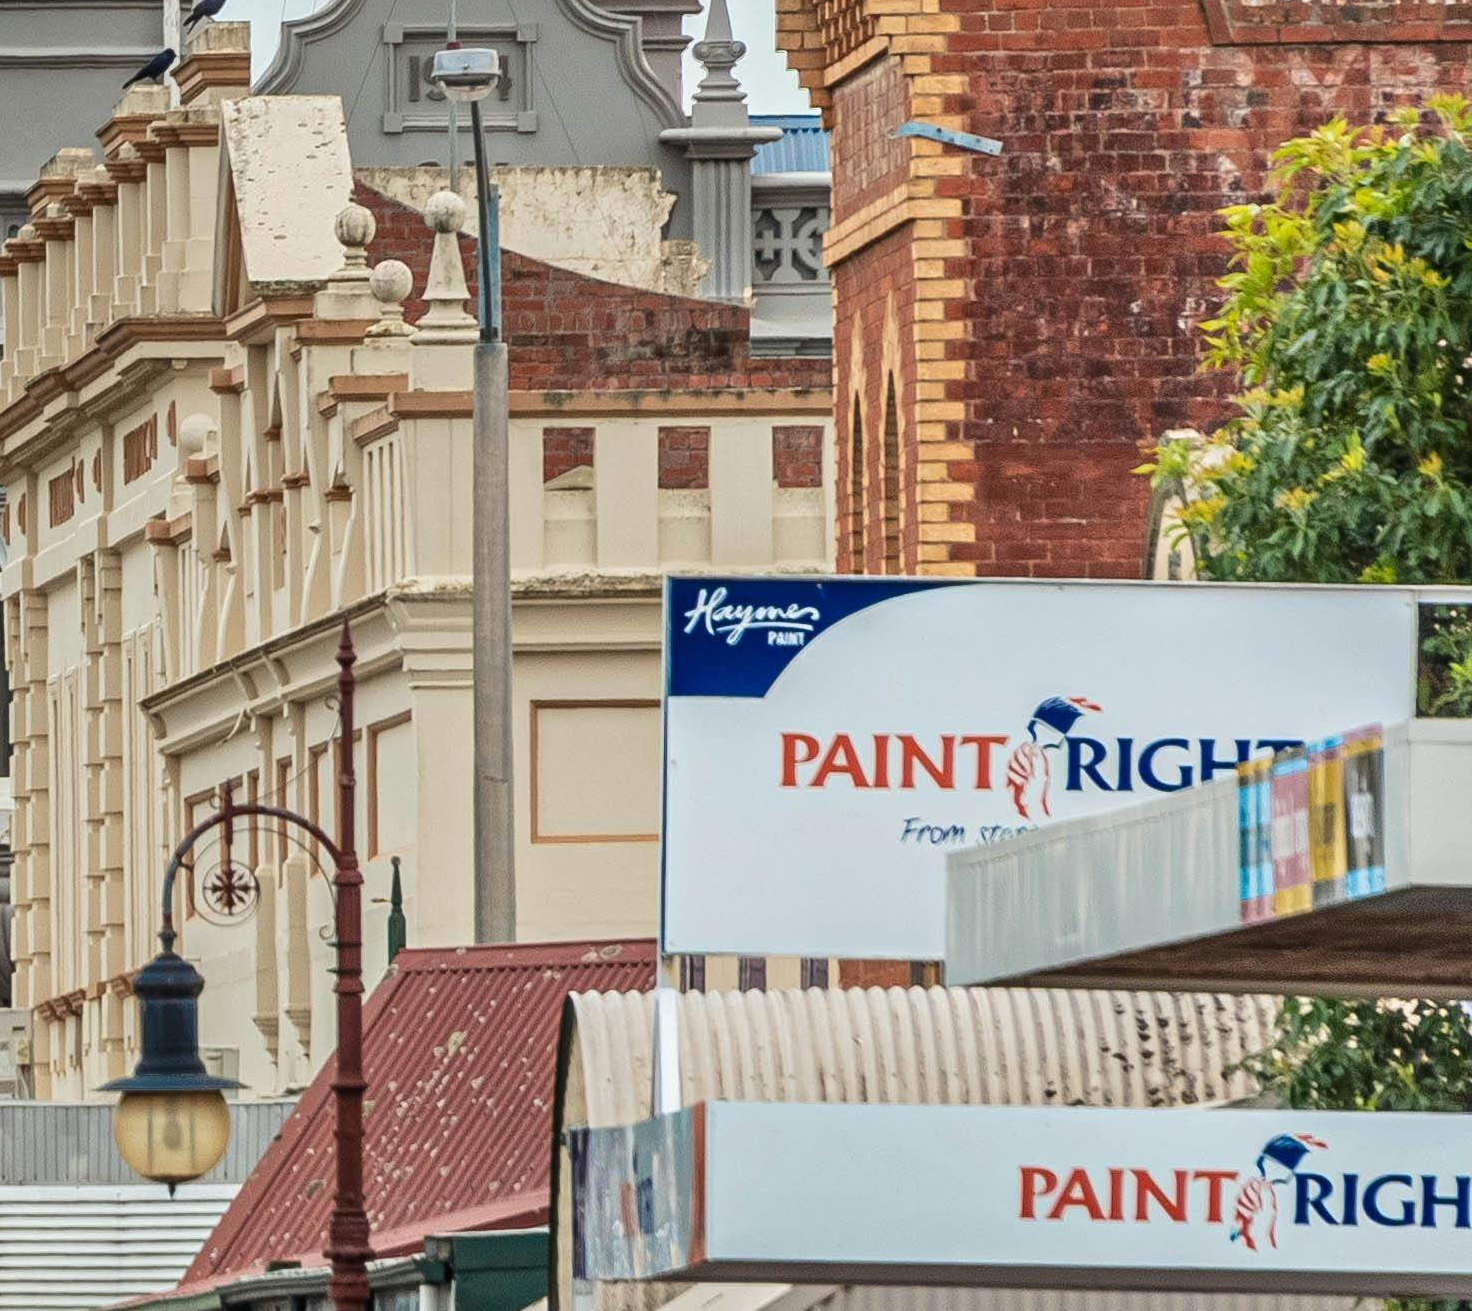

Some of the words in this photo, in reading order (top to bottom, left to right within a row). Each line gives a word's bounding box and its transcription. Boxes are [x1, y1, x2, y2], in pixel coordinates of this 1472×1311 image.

[684, 587, 821, 646] Haymes
[768, 631, 805, 646] PAINT
[779, 732, 1008, 790] PAINT
[901, 817, 966, 845] From
[1018, 1166, 1238, 1223] PAINT
[1294, 1173, 1472, 1227] RIGH
